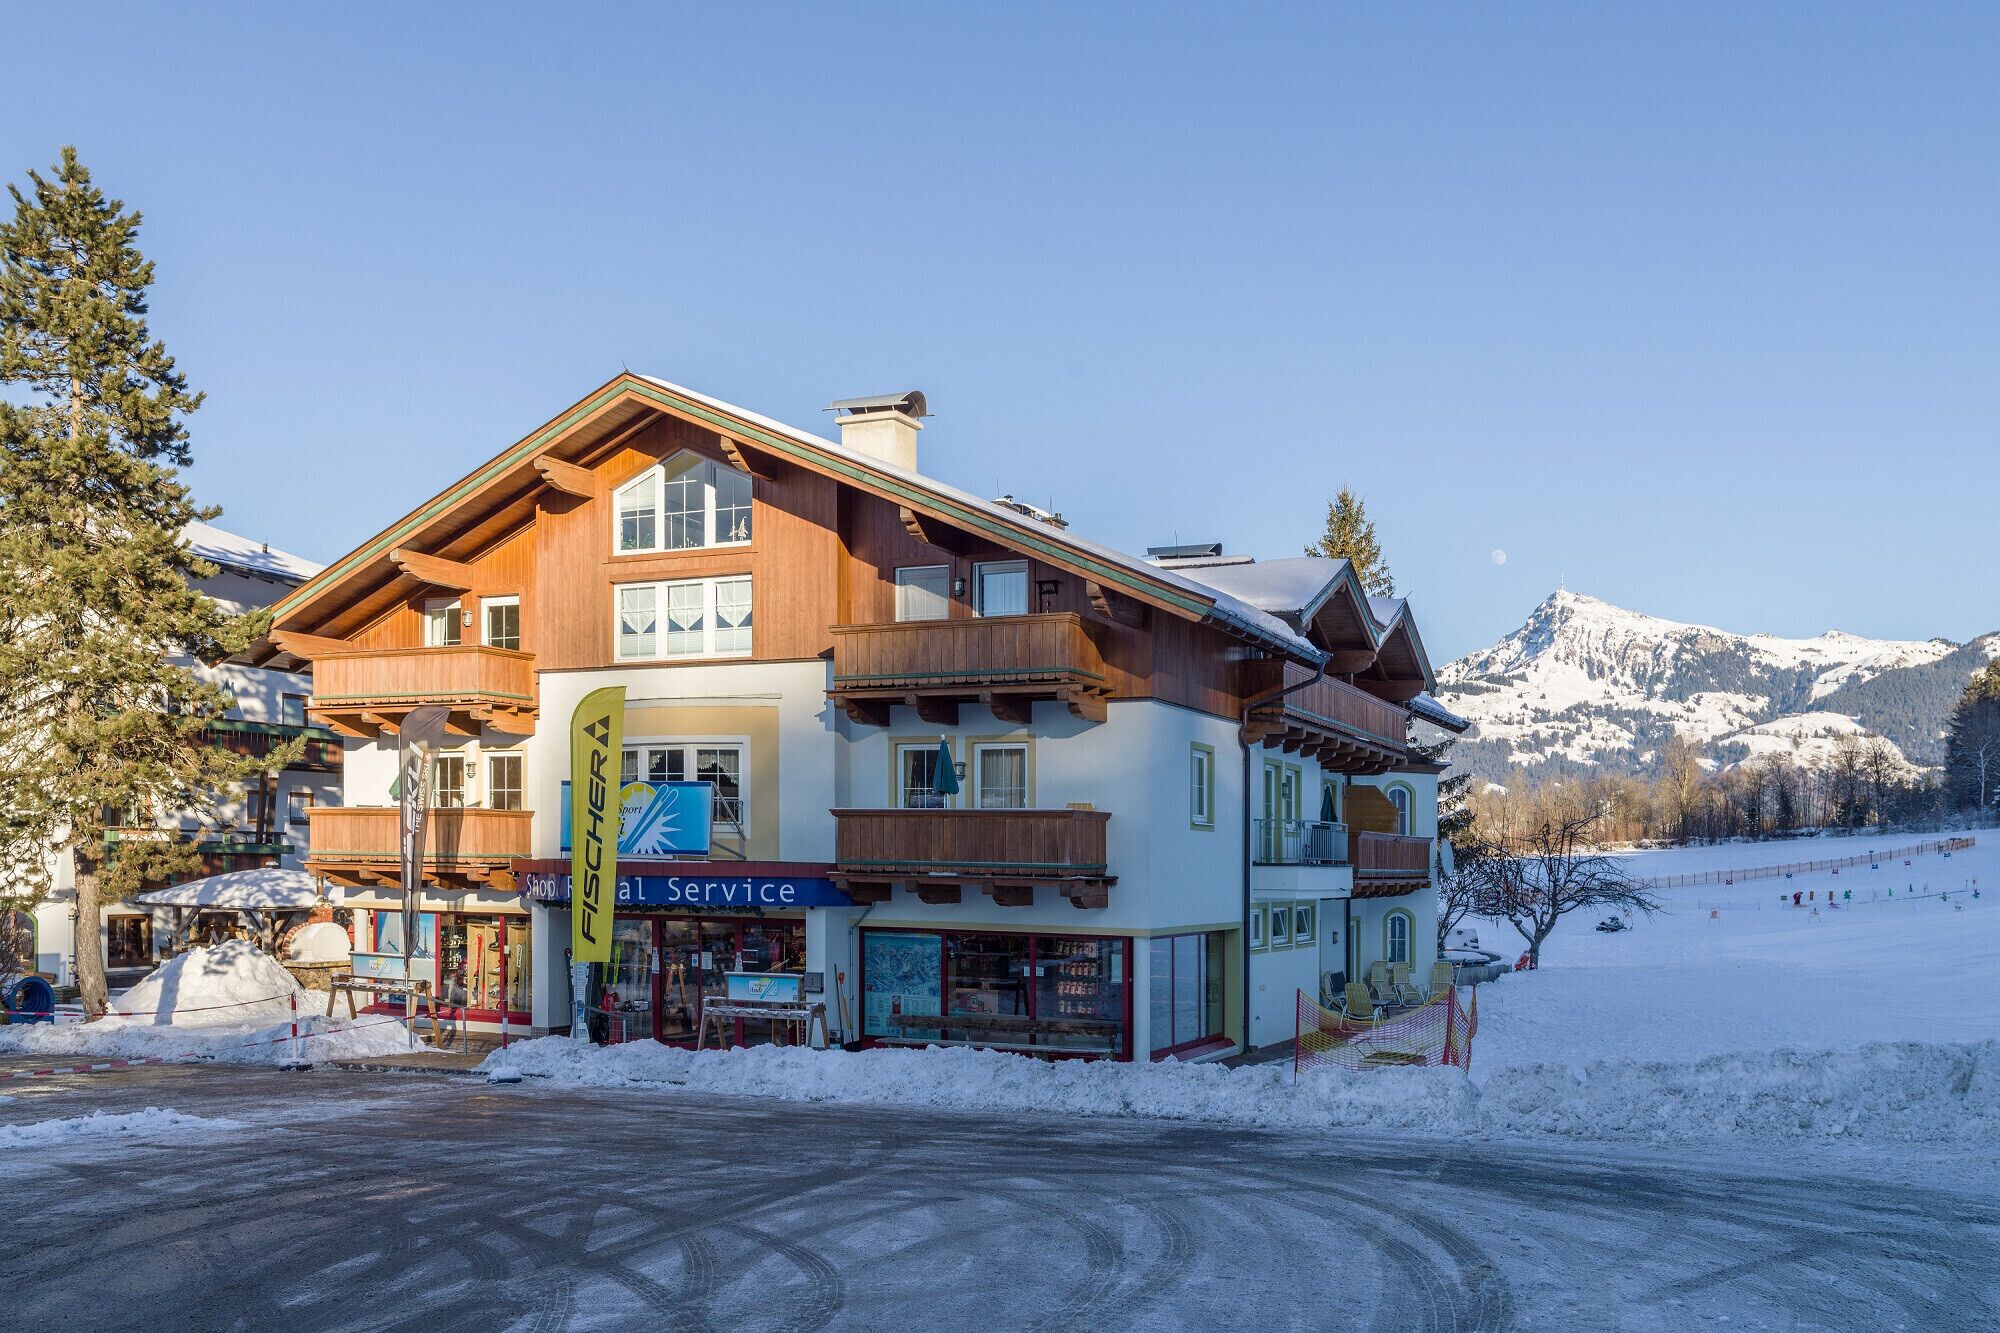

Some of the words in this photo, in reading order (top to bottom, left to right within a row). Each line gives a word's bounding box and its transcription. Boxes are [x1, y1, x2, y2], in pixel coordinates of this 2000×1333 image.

[422, 763, 430, 780] SKI
[417, 781, 426, 812] SWISS
[415, 813, 423, 833] THE
[582, 748, 608, 946] FISCHER
[526, 873, 556, 901] Shop
[567, 875, 646, 900] Ral
[668, 876, 795, 902] Service
